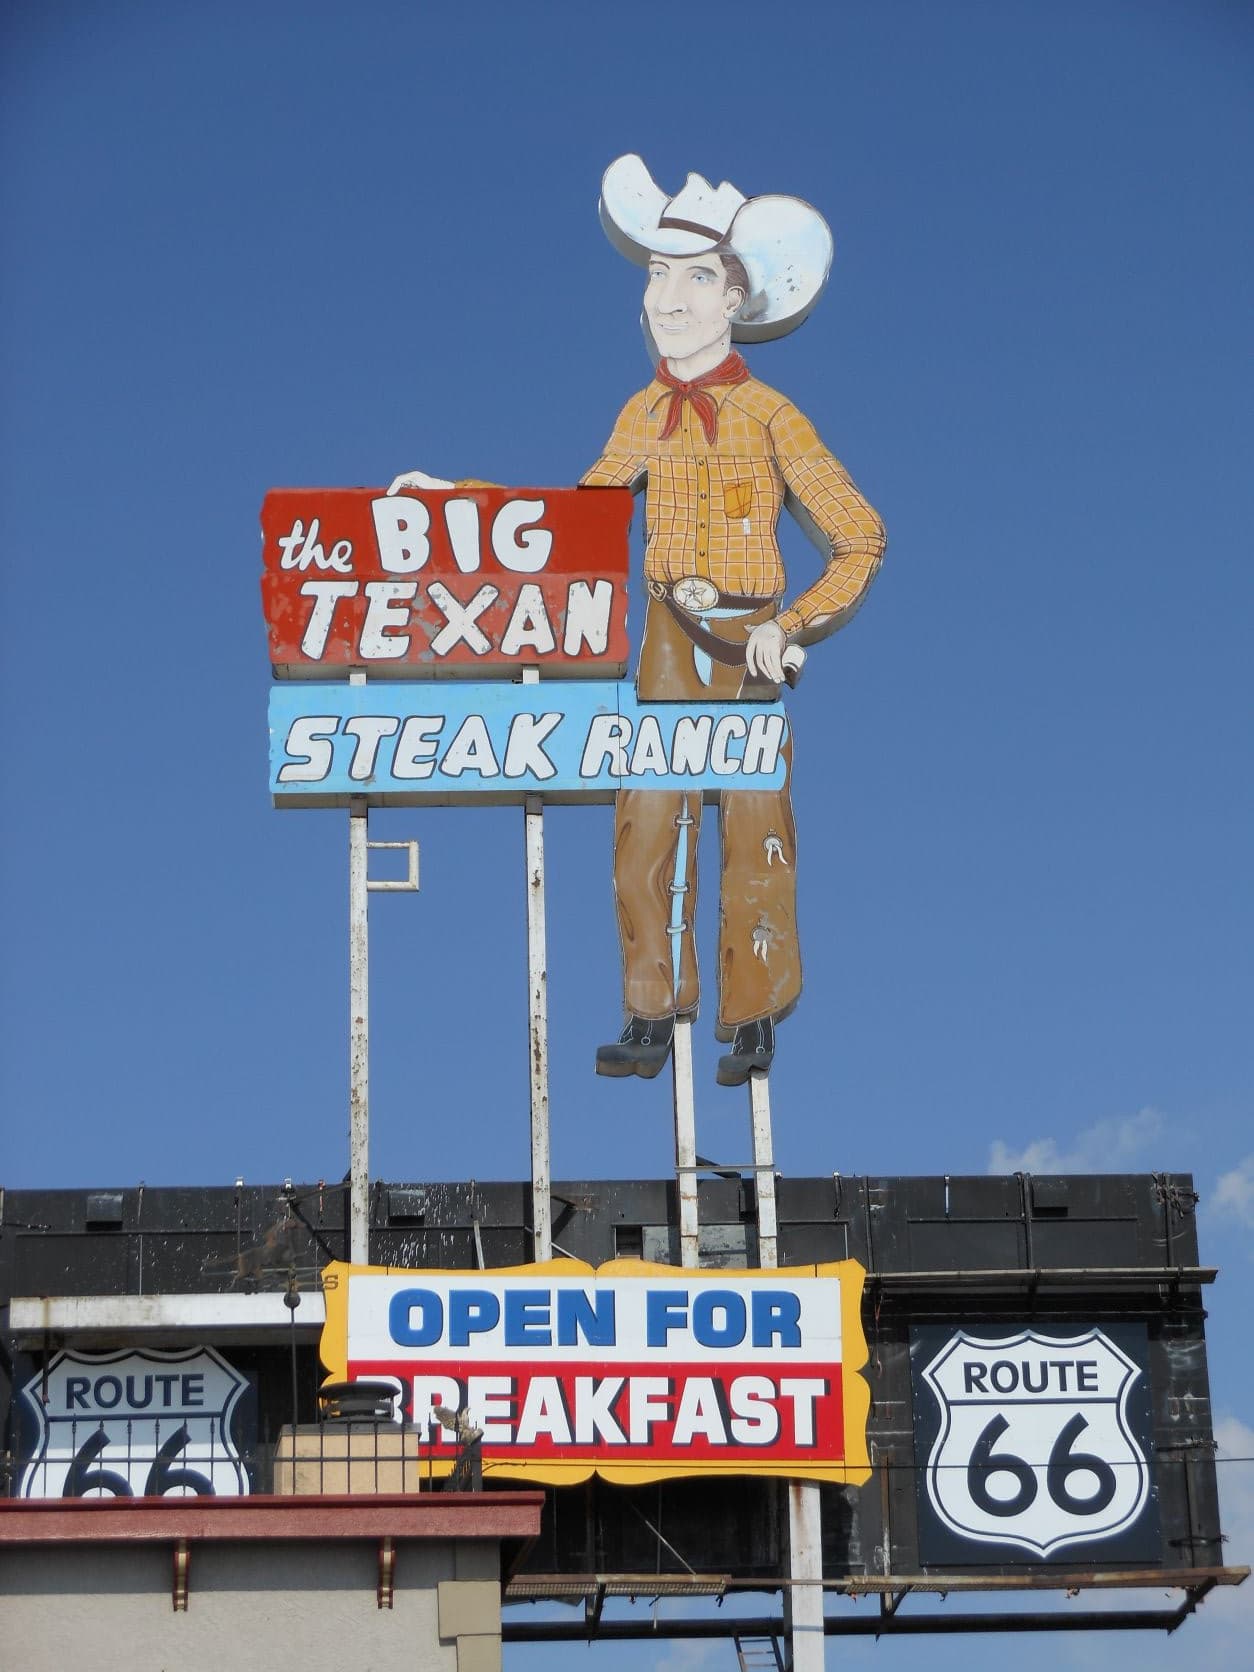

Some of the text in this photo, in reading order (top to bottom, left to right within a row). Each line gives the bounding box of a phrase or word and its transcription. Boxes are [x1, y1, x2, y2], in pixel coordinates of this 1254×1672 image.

[278, 496, 553, 573] the BIG
[300, 580, 613, 660] TEXAN
[276, 712, 786, 783] STEAK RANCH
[389, 1288, 802, 1348] OPEN FOR
[66, 1374, 205, 1409] ROUTE
[355, 1375, 826, 1447] REAKFAST
[963, 1360, 1099, 1394] ROUTE
[967, 1412, 1117, 1518] 66
